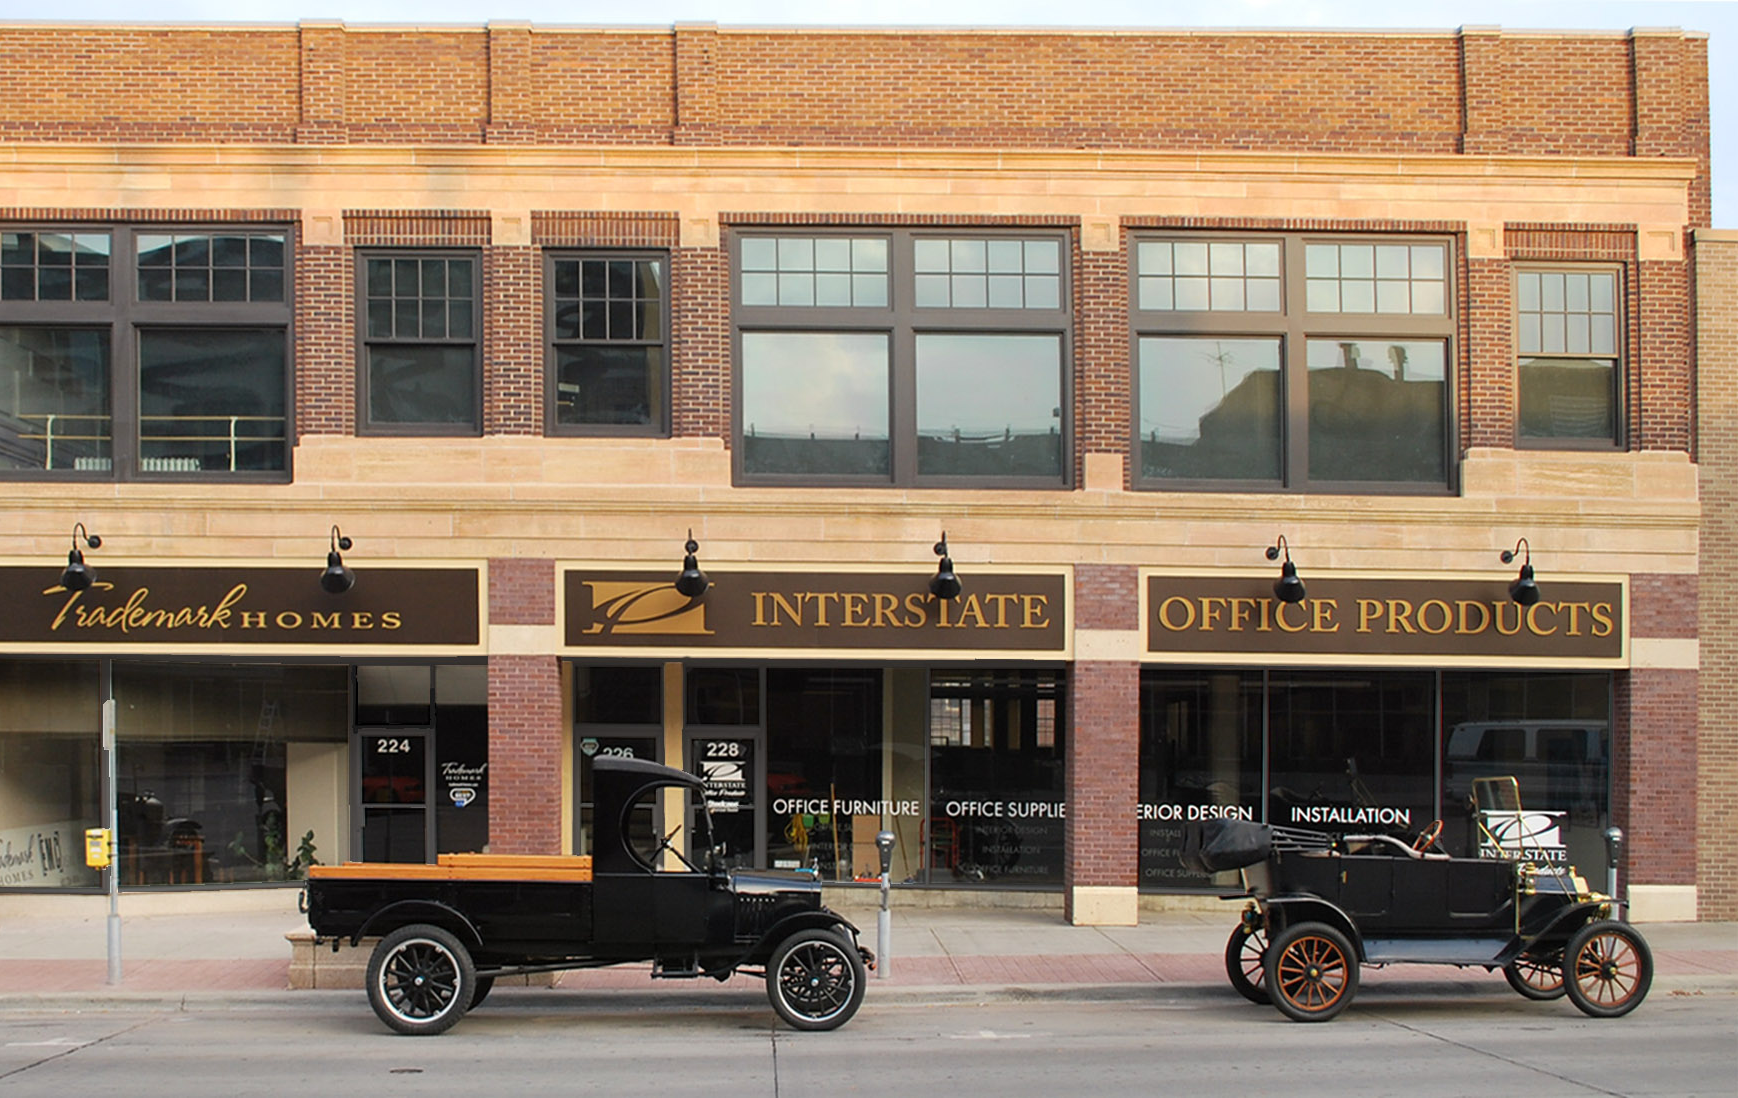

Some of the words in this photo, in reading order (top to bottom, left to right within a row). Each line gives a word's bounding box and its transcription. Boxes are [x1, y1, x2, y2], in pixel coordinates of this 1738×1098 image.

[42, 582, 248, 634] Trademark
[239, 610, 403, 630] HOMES
[750, 591, 1050, 629] INTERSTATE
[1158, 596, 1341, 633] OFFICE
[1355, 598, 1614, 637] PRODUCTS
[376, 738, 411, 753] 224
[602, 746, 634, 759] 226
[706, 741, 740, 757] 228
[772, 798, 829, 815] OFFICE
[833, 799, 920, 816] FURNITURE
[945, 800, 1004, 818] OFFICE
[1187, 804, 1254, 821] DESIGN
[1290, 805, 1412, 824] INSTALLATION
